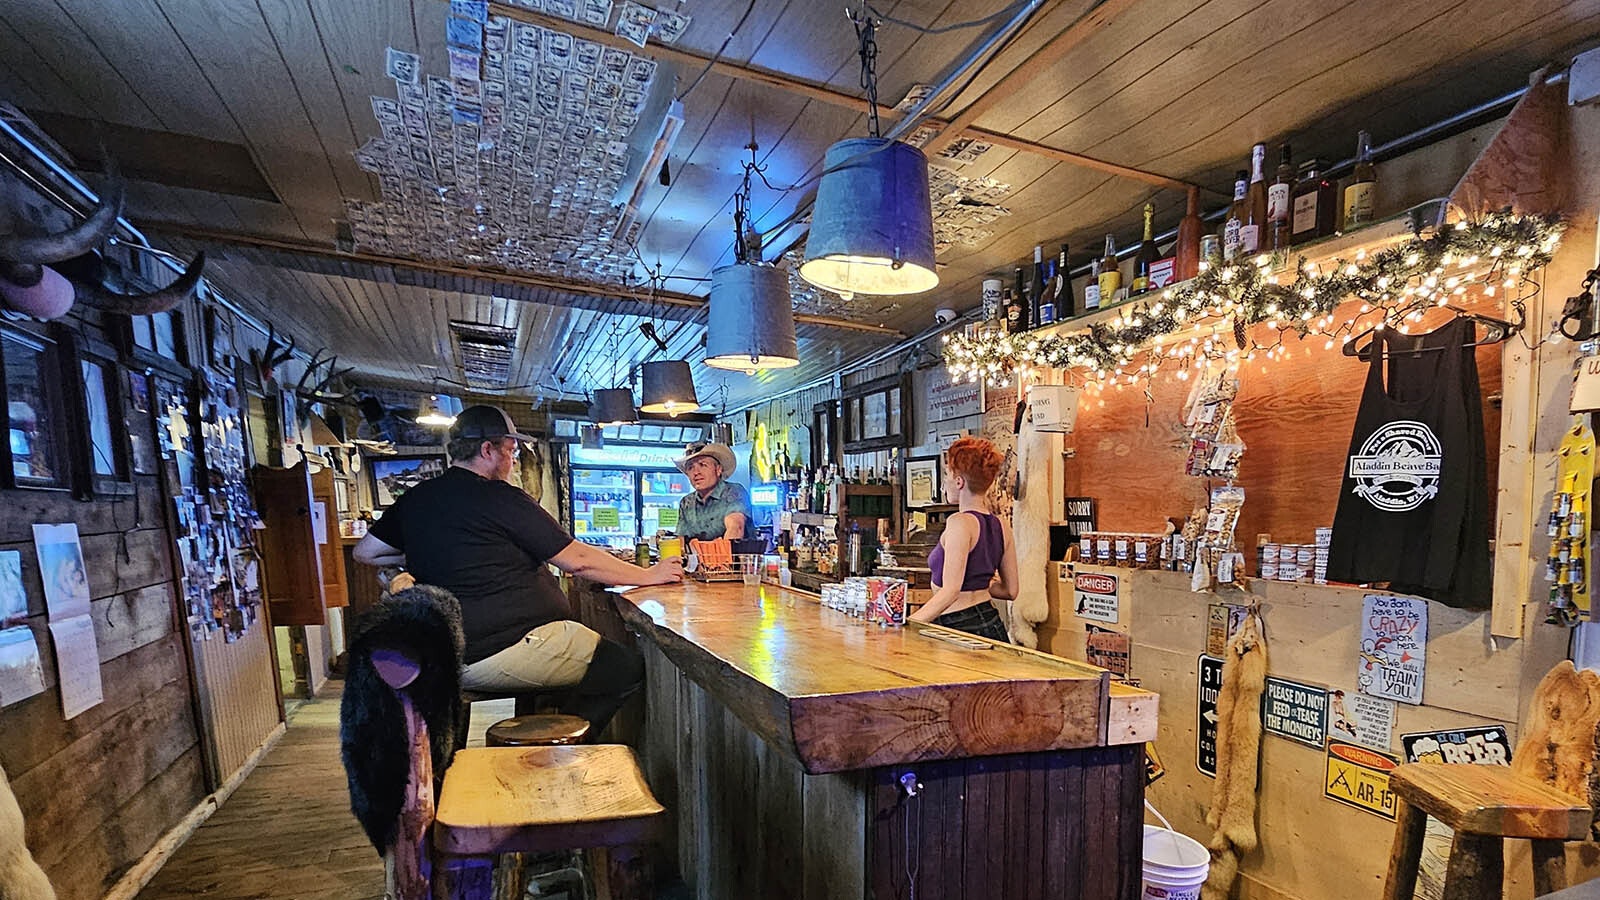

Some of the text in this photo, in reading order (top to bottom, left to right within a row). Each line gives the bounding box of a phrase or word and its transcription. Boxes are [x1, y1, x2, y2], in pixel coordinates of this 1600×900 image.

[1356, 462, 1390, 470] Aladdin
[1426, 462, 1440, 470] Ba
[1068, 501, 1091, 516] SORRY
[1077, 578, 1113, 591] DANGER
[1375, 598, 1412, 608] You don't
[1372, 607, 1392, 616] have
[1408, 611, 1419, 620] be
[1370, 616, 1419, 635] CRAZY
[1204, 666, 1210, 682] 3
[1388, 659, 1418, 673] We will
[1381, 667, 1417, 686] TRAIN
[1268, 684, 1324, 711] PLEASE DO NOT
[1385, 681, 1412, 698] YOU.
[1273, 702, 1290, 717] FEED
[1297, 707, 1319, 725] TEASE
[1267, 714, 1322, 740] THE MONKEYS
[1201, 740, 1214, 752] COL
[1440, 734, 1510, 768] BEER
[1344, 747, 1382, 766] WARNING
[1361, 772, 1386, 783] PROTECTED
[1357, 782, 1393, 809] AR-15
